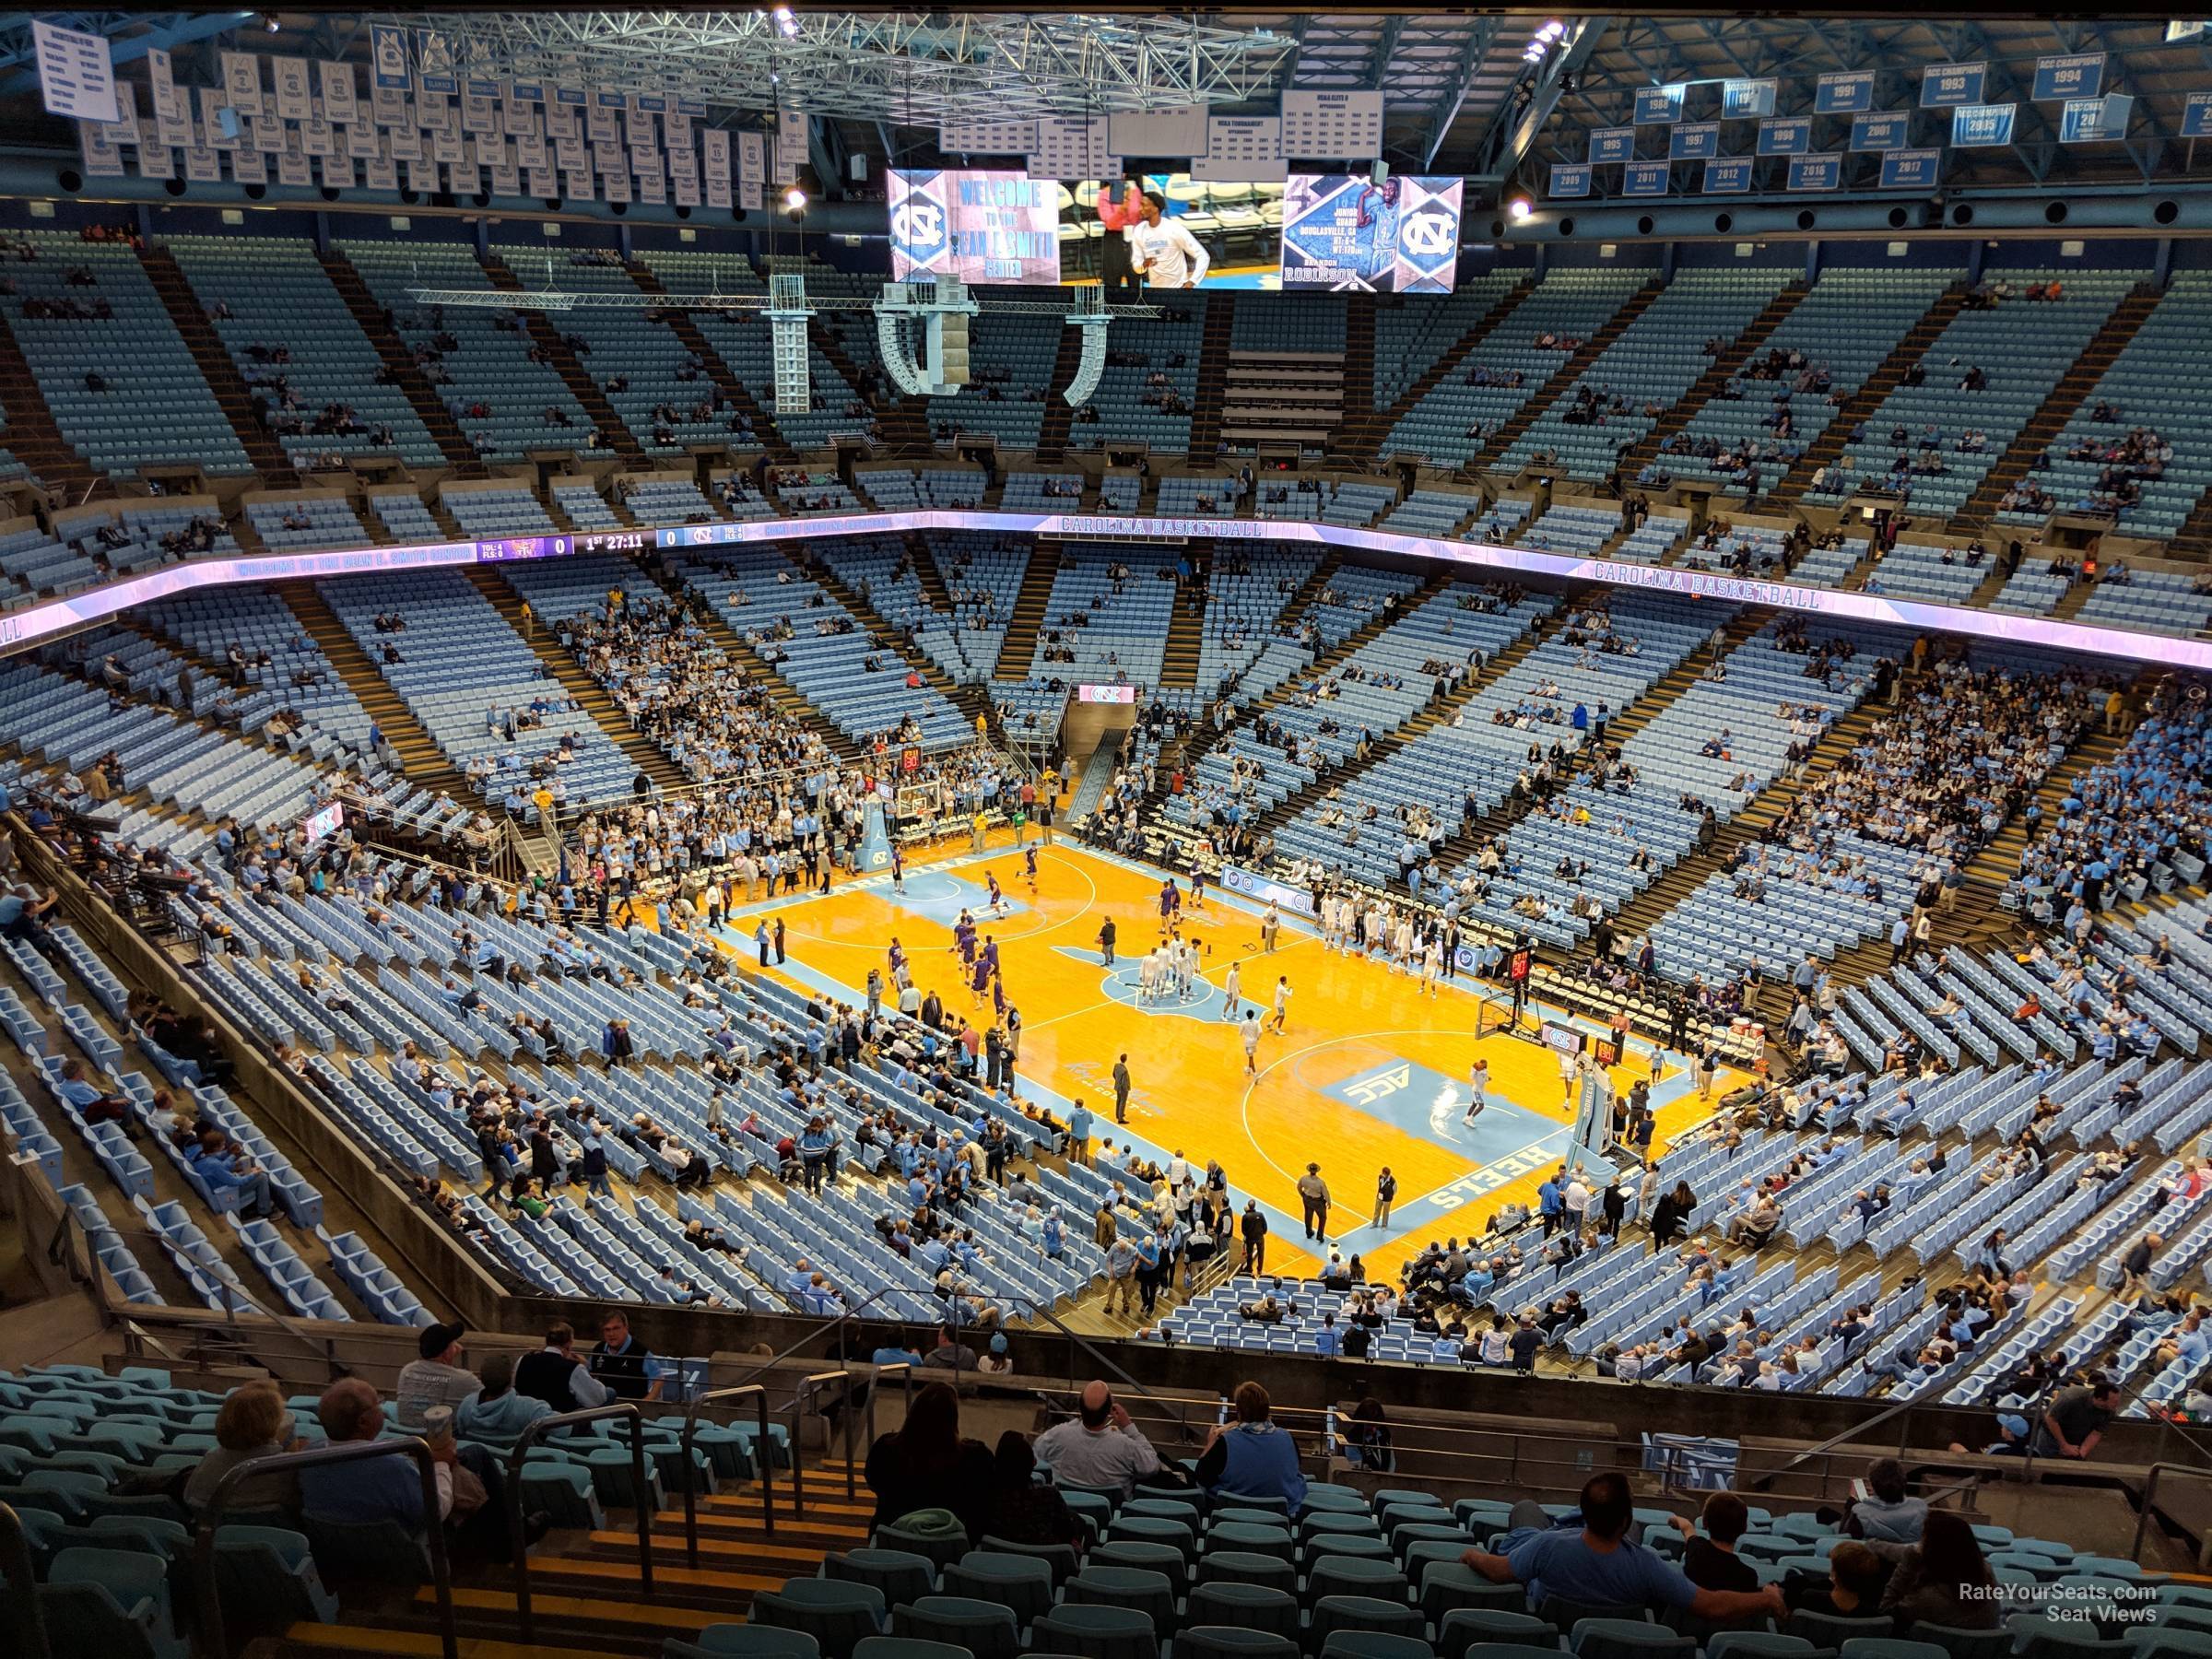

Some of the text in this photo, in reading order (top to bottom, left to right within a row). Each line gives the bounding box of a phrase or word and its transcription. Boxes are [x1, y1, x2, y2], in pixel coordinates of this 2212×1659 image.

[2040, 56, 2101, 69] ACC CHAMPIONS
[1927, 65, 1983, 76] ACC CHAMPIONS
[2054, 70, 2081, 83] 1994
[1820, 73, 1874, 84] ACC CHAMPIONS
[1940, 77, 1965, 90] 1993
[1833, 86, 1855, 97] 1991
[2080, 113, 2096, 126] 20
[1867, 125, 1889, 136] 2001
[1603, 139, 1621, 150] 1995
[1685, 135, 1703, 146] 1997
[713, 149, 722, 158] 15
[1803, 165, 1825, 176] 2016
[1898, 161, 1922, 173] 2017
[1561, 175, 1580, 185] 2009
[1637, 173, 1656, 182] 2011
[1717, 169, 1738, 180] 2012
[959, 180, 1042, 207] WELCOME
[1286, 177, 1311, 213] 4
[1335, 208, 1358, 218] JUNIOR
[1336, 218, 1357, 226] GUARD
[1006, 232, 1053, 258] SMITH
[985, 259, 1022, 278] CENTER
[1284, 267, 1358, 282] ROBINSON
[1062, 516, 1263, 537] CAROLINA BASKETBALL
[586, 534, 643, 551] 1ST 27:11
[666, 531, 676, 546] 0
[555, 539, 566, 554] 0
[1594, 562, 1820, 609] CAROLINA BASKETBALL
[905, 757, 917, 768] 30
[1343, 1063, 1411, 1106] ACC
[1429, 1144, 1559, 1209] HEELS
